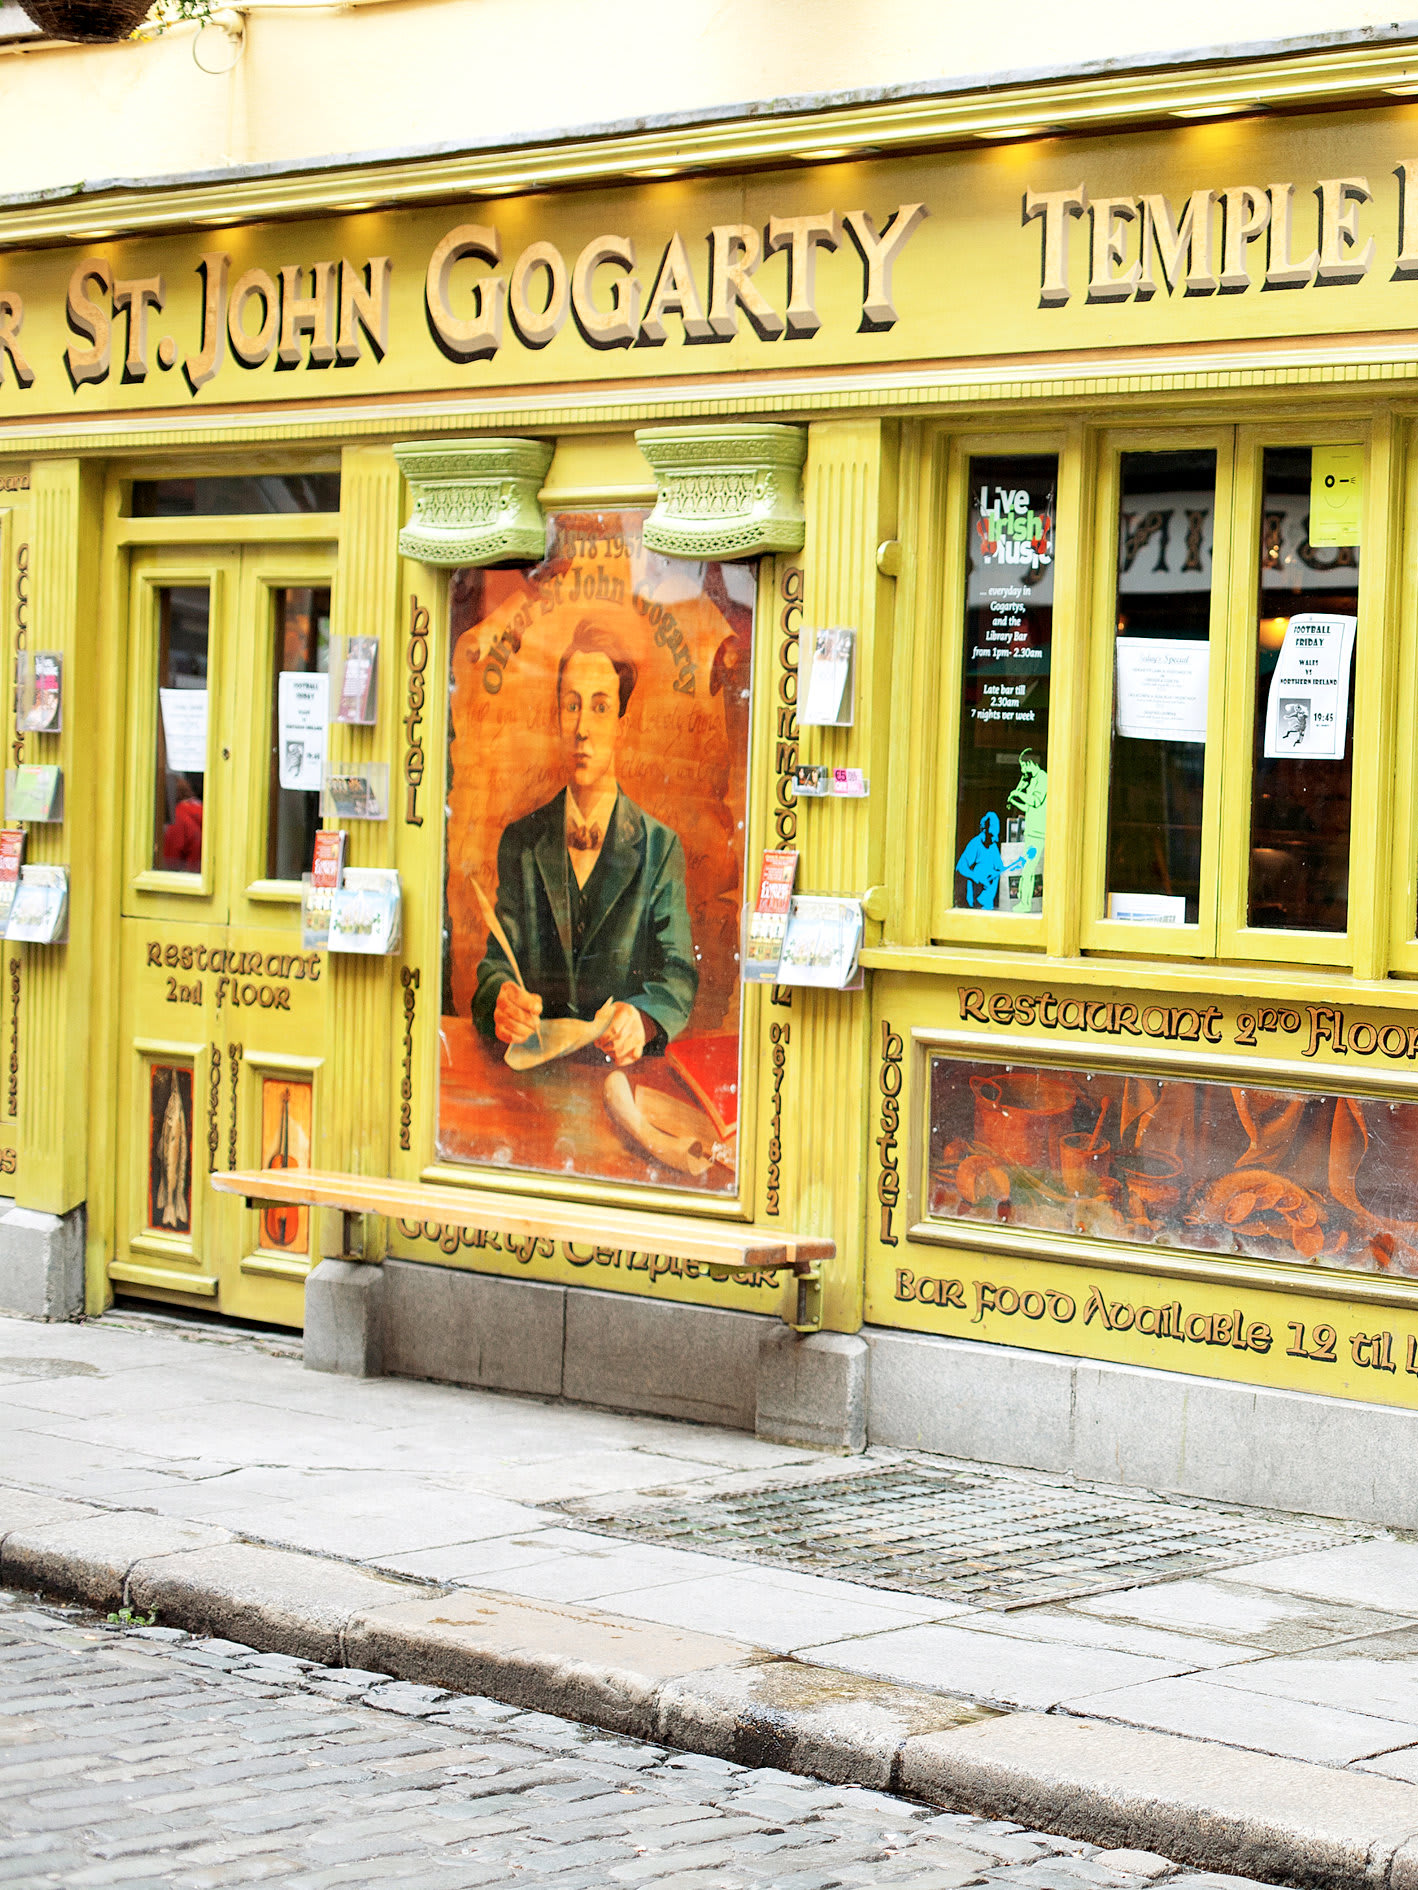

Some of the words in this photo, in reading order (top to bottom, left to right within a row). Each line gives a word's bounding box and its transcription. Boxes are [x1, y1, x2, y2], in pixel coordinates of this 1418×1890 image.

[181, 250, 393, 397] JOHN
[425, 201, 928, 365] GOGARTY
[1021, 174, 1376, 309] TEMPLE
[980, 486, 1030, 520] Live
[988, 510, 1042, 542] Irish
[988, 586, 1021, 598] everyday
[1023, 586, 1031, 596] in
[992, 616, 1007, 626] and
[1008, 616, 1021, 627] the
[483, 599, 533, 695] Oliver
[569, 565, 625, 606] John
[632, 580, 698, 699] Gogarty
[1294, 625, 1331, 635] FOOTBALL
[986, 630, 1013, 644] Library
[1013, 631, 1028, 642] Bar
[1295, 638, 1325, 647] FRIDAY
[971, 647, 991, 660] from
[1013, 647, 1042, 659] 2.30am
[1280, 678, 1312, 686] NORTHERN
[983, 684, 999, 695] Late
[1000, 684, 1014, 696] bar
[1014, 684, 1026, 696] till
[990, 697, 1019, 708] 2.30am
[971, 709, 976, 718] 7
[977, 709, 1001, 721] nights
[1016, 710, 1036, 721] week
[145, 940, 322, 982] Restaurant
[165, 976, 202, 1008] 2nd
[957, 987, 1223, 1044] Restaurant
[1234, 1006, 1301, 1046] 2nd
[894, 1267, 966, 1309] Bar
[1082, 1286, 1273, 1353] Available
[1286, 1320, 1338, 1362] 12
[1349, 1330, 1396, 1373] til
